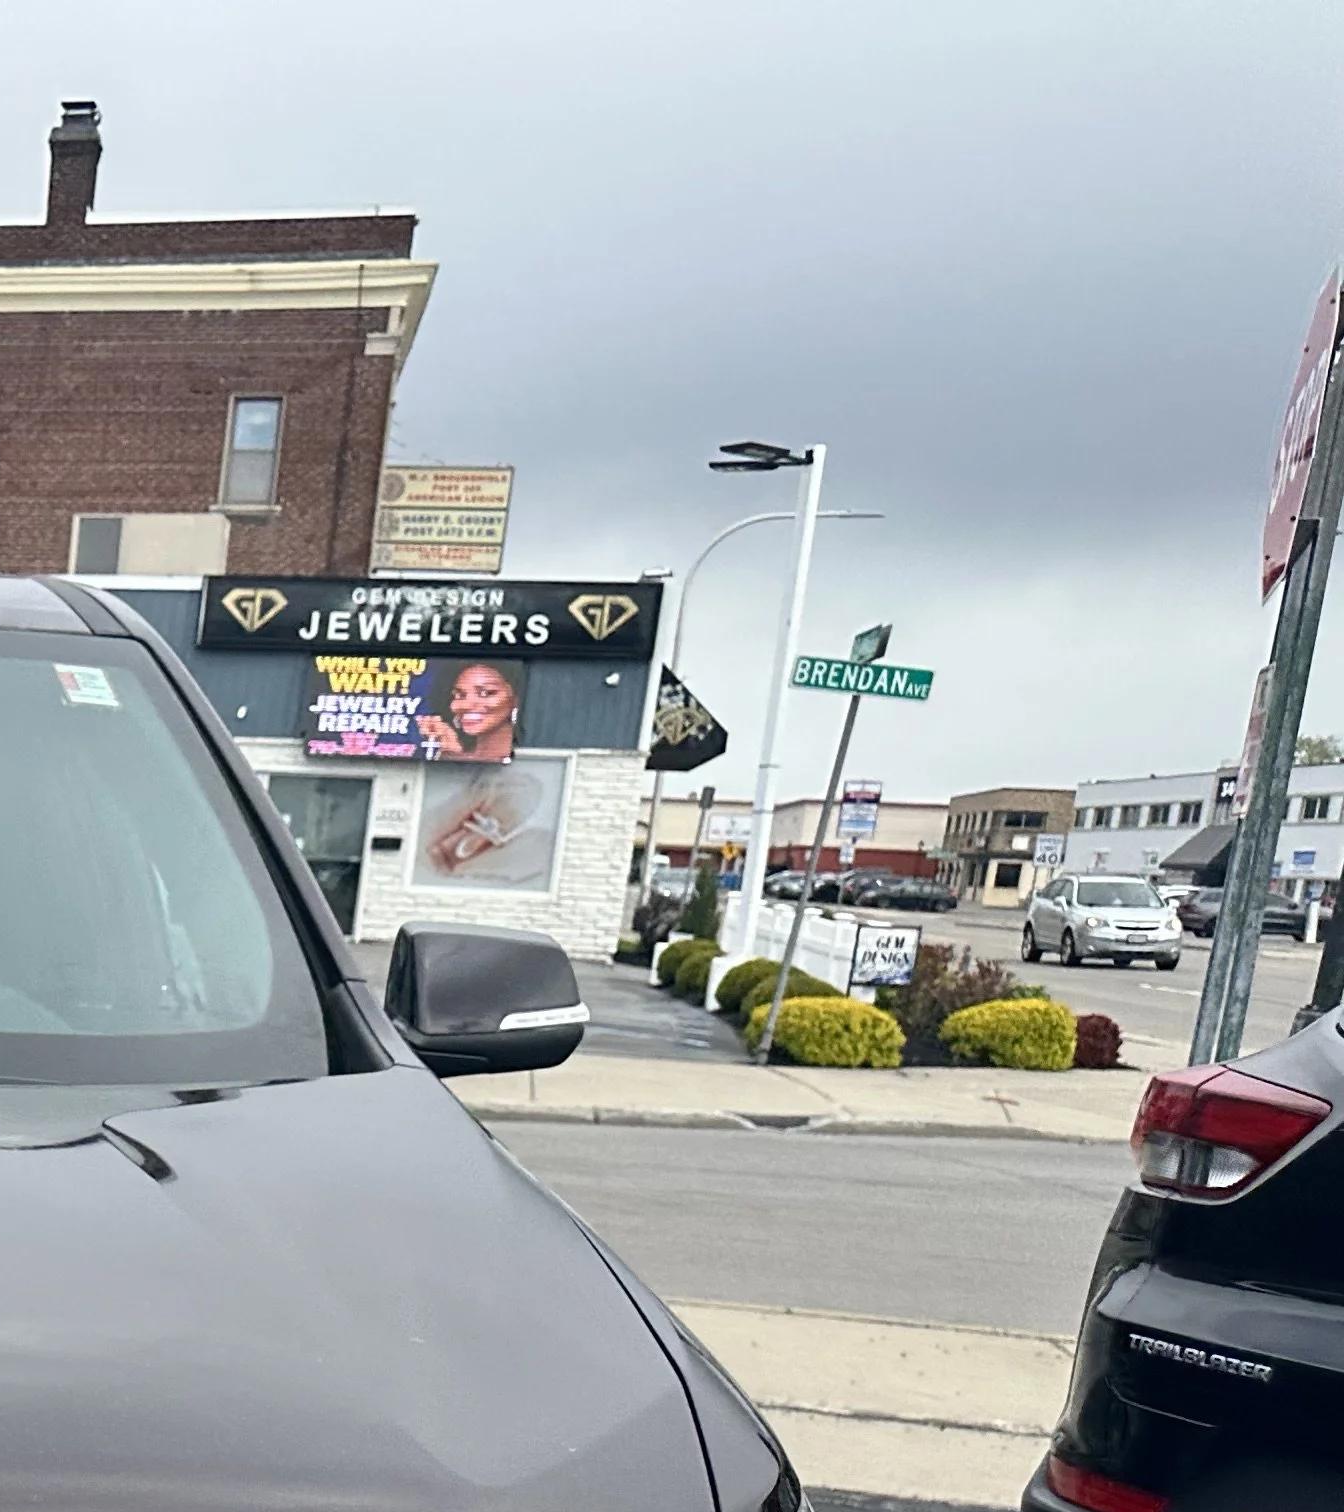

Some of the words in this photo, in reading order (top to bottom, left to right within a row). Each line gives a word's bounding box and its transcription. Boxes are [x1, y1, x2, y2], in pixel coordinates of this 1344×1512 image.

[403, 527, 433, 536] POST
[351, 587, 401, 605] GEM
[410, 588, 505, 606] DESIGN
[298, 611, 552, 645] JEWELERS
[316, 656, 381, 673] WHILE
[385, 657, 427, 675] YOU
[329, 673, 411, 694] WAIT!
[794, 658, 909, 696] BRENDAN
[906, 681, 930, 698] AVE
[309, 695, 421, 714] JEWELRY
[318, 713, 410, 734] REPAIR
[1036, 853, 1058, 865] 40
[1129, 1333, 1273, 1384] TRAILBLAZER
